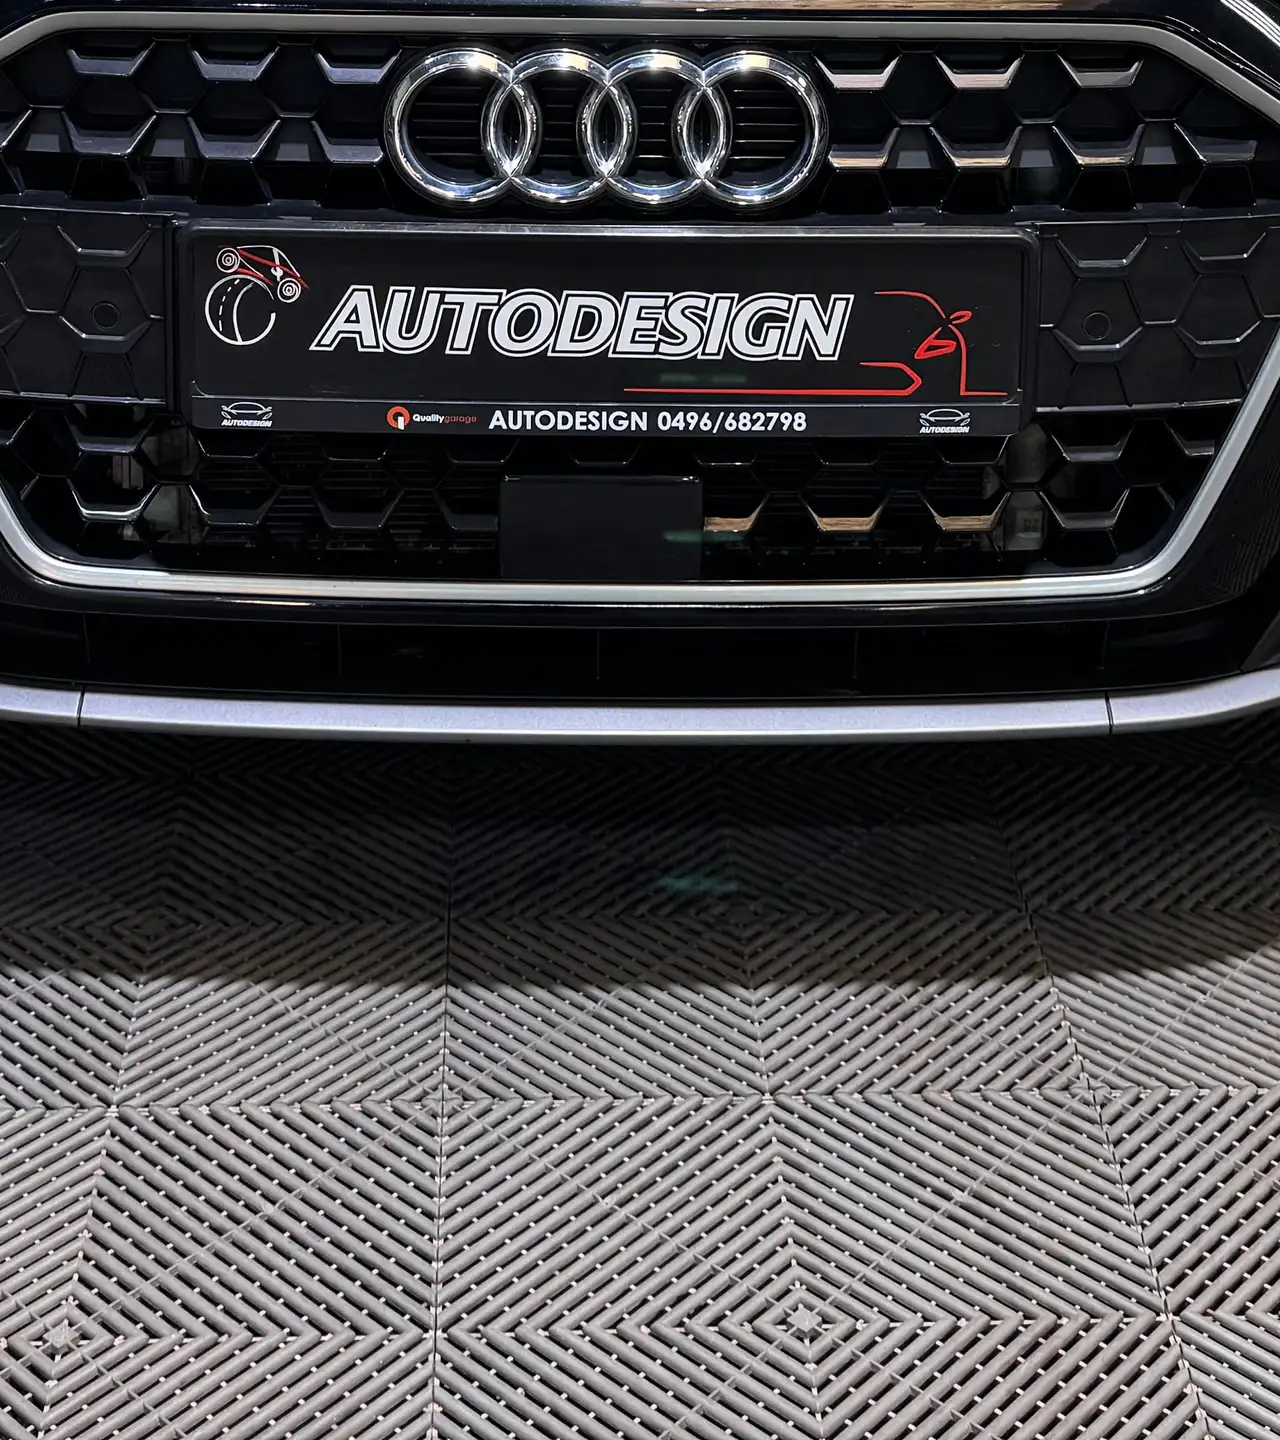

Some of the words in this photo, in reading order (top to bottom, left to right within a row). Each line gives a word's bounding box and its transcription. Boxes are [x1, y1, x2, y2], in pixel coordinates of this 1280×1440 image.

[310, 284, 854, 361] AUTODESIGN
[221, 418, 272, 428] AUTODESIGN
[412, 413, 477, 425] Qualitygarage
[488, 408, 649, 431] AUTODESIGN
[657, 410, 807, 433] 0496/682798
[919, 426, 970, 434] AUTODESIGN
